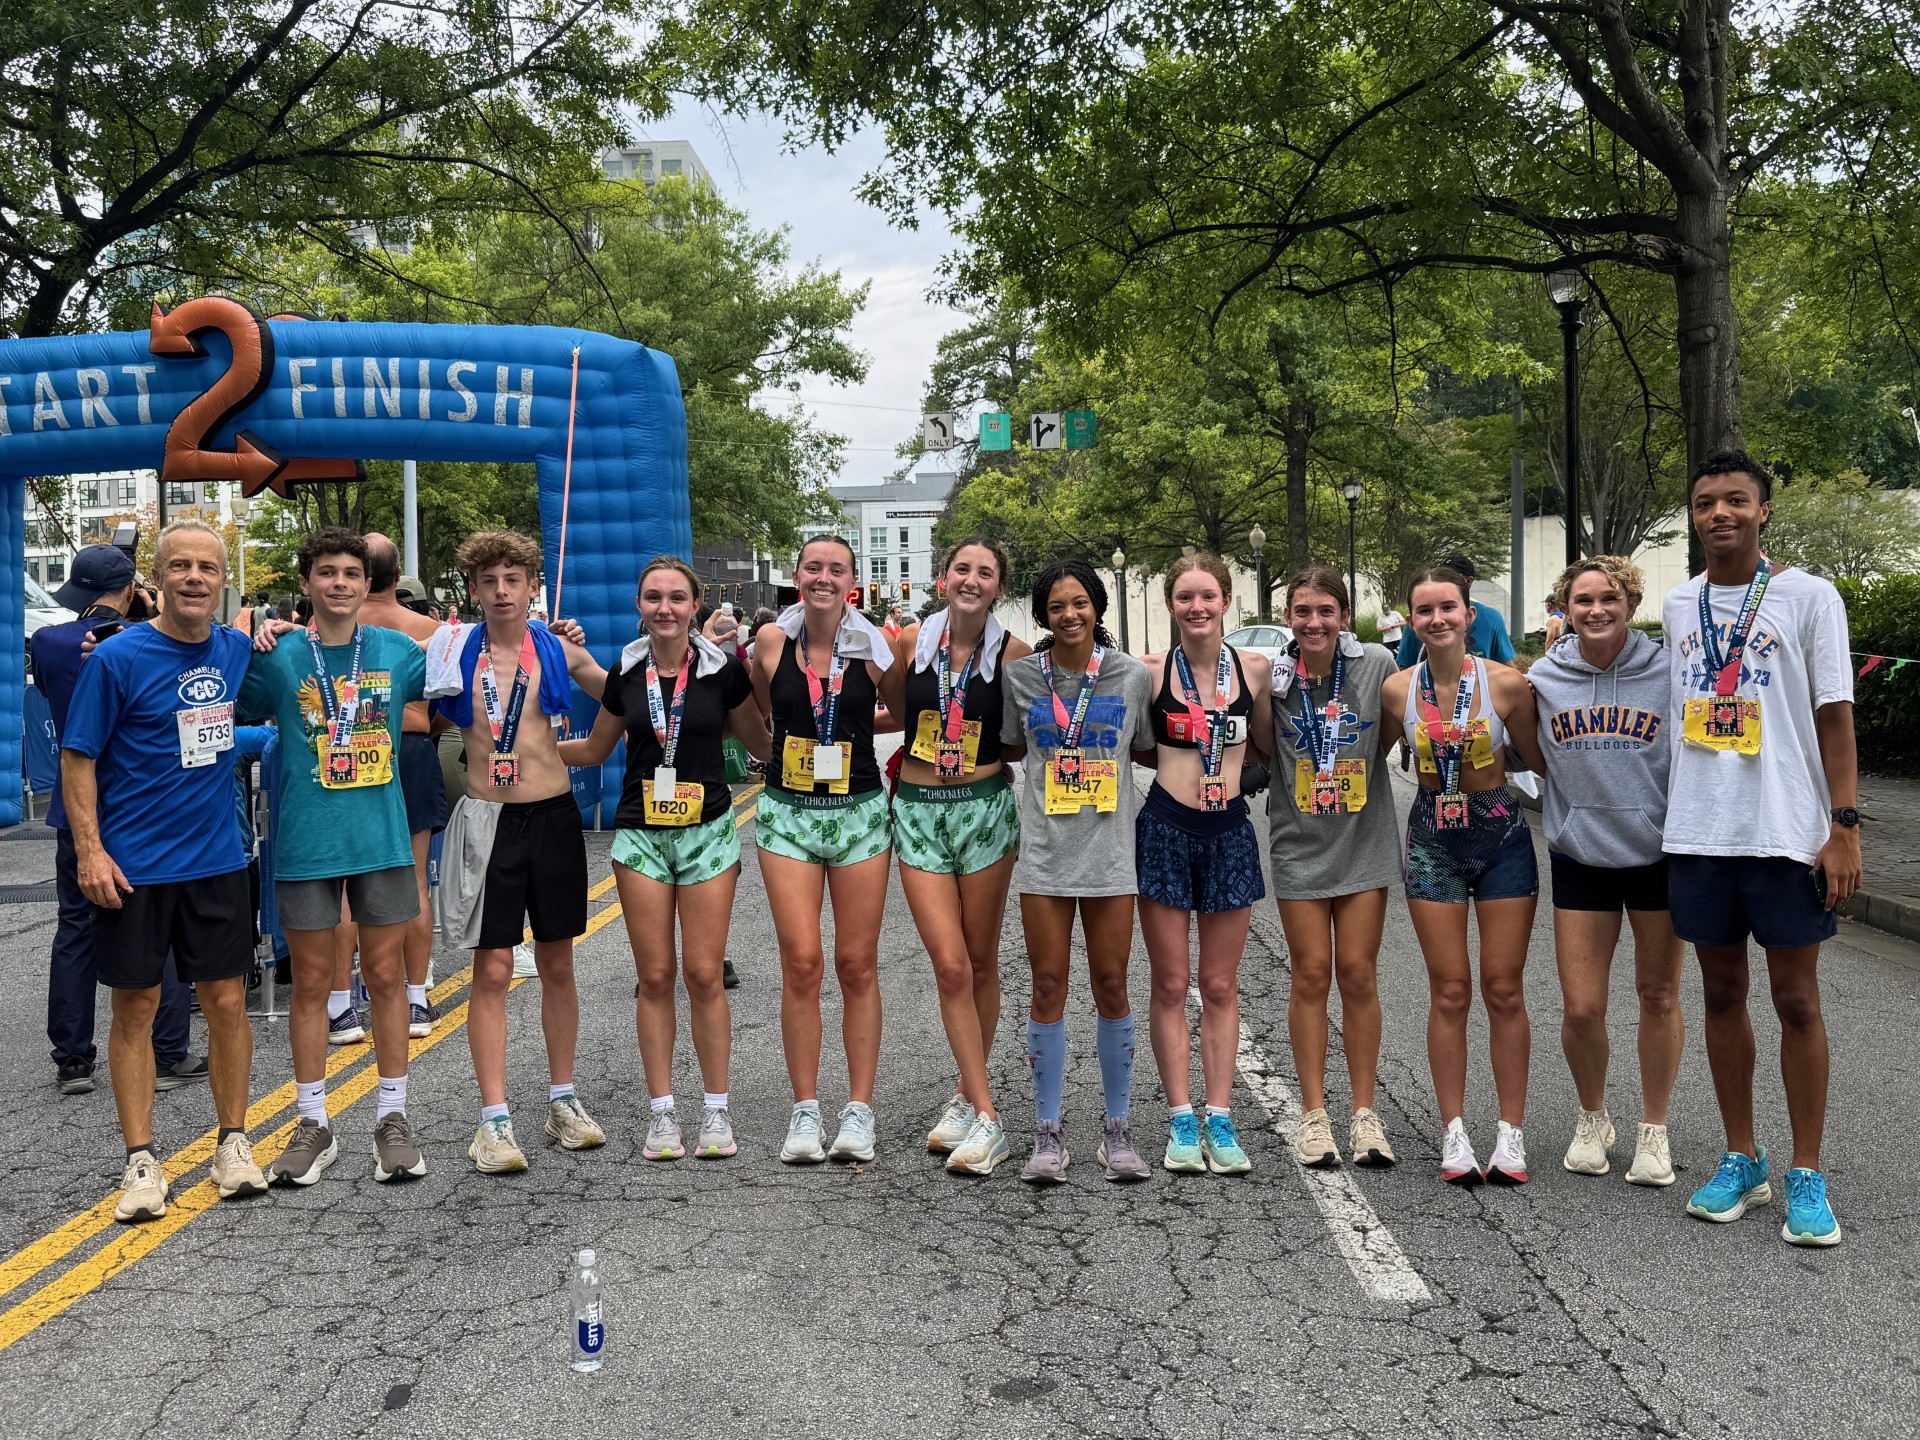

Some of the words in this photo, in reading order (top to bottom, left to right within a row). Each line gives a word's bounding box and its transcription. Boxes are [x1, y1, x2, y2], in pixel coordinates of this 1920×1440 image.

[0, 365, 156, 436] TART
[288, 357, 534, 428] FINISH
[928, 439, 950, 447] ONLY
[1744, 571, 1763, 611] CELEBRATION
[1744, 610, 1755, 630] PEACH
[1750, 583, 1766, 610] SIZZLER
[1738, 611, 1747, 628] YEAR
[1735, 627, 1742, 635] 15
[177, 666, 222, 682] CHAMBLEE
[1218, 662, 1226, 686] LABOR
[1753, 669, 1771, 687] 23
[482, 677, 490, 690] DAY
[484, 690, 494, 715] LABOR
[490, 686, 498, 702] 2025
[648, 689, 656, 702] DAY
[340, 706, 348, 722] DAY
[649, 702, 659, 724] LABOR
[1067, 723, 1076, 738] YEAR
[1072, 688, 1087, 723] CELEBRATION
[1077, 698, 1089, 722] SIZZLER
[1454, 695, 1465, 719] LABOR
[198, 723, 230, 743] 5733
[335, 721, 346, 746] LABOR
[344, 719, 353, 736] 2025
[1324, 725, 1332, 741] DAY
[1551, 705, 1664, 746] CHAMBLEE
[1210, 725, 1220, 763] CELEBRATION
[1216, 736, 1224, 763] SIZZLER
[1321, 741, 1331, 764] LABOR
[1330, 737, 1338, 754] 2025
[1566, 741, 1640, 750] BULLDOGS
[358, 749, 380, 765] 00
[798, 756, 814, 770] 15
[1445, 760, 1455, 794] ELEBRATION
[1451, 771, 1460, 794] IZZLER
[927, 787, 973, 800] CHICKNLEGS
[1065, 779, 1102, 794] 1547
[650, 801, 689, 815] 1620
[804, 794, 854, 807] CHICKNLEGS
[586, 1301, 599, 1347] smart
